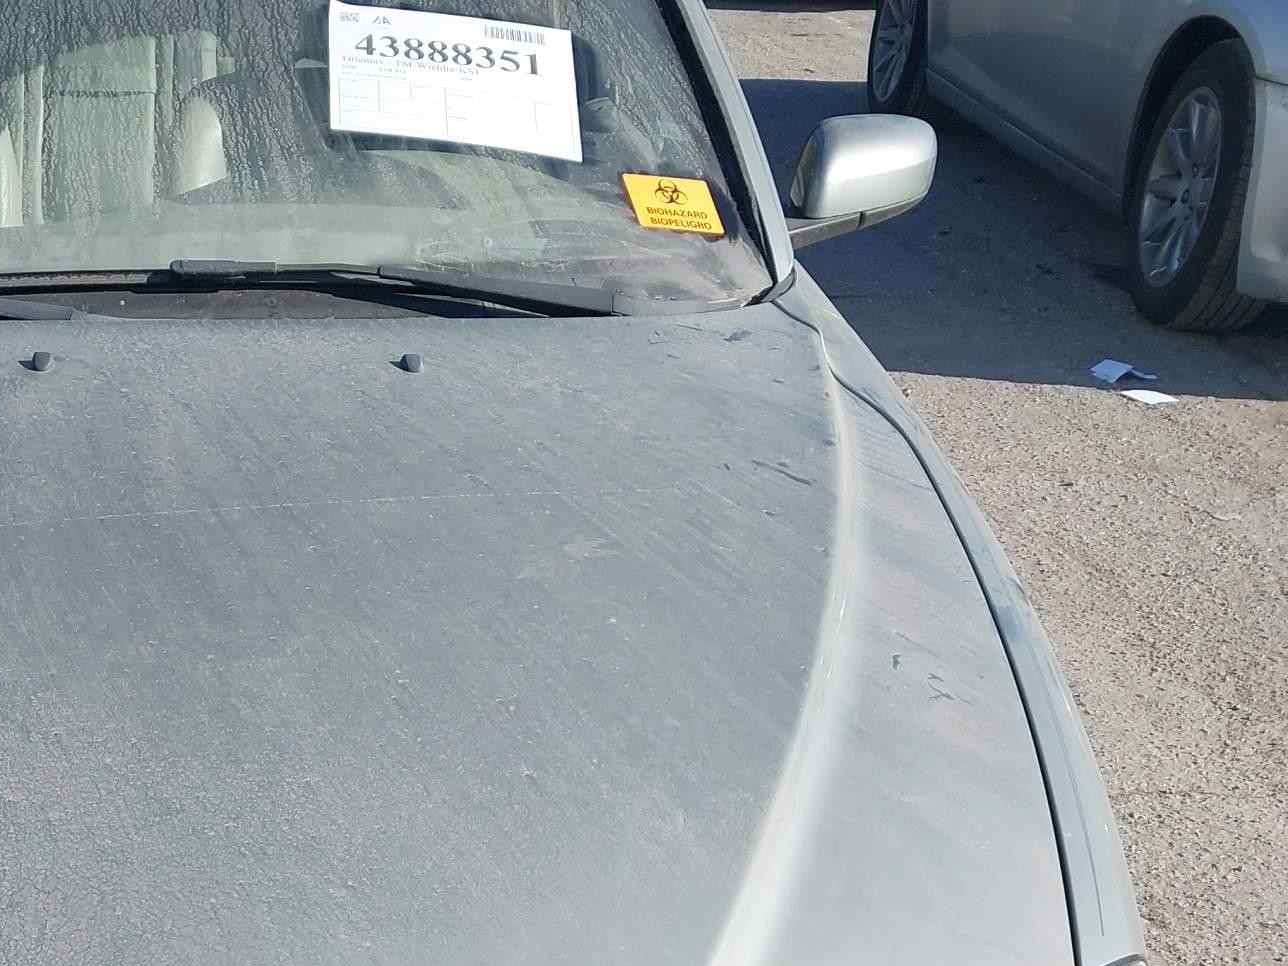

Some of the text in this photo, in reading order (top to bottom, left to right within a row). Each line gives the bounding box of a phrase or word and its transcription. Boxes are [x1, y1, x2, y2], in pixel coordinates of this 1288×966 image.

[355, 33, 543, 77] 43888351
[646, 206, 708, 219] BIOHAZARD
[650, 217, 712, 230] BIOPELIGRO
